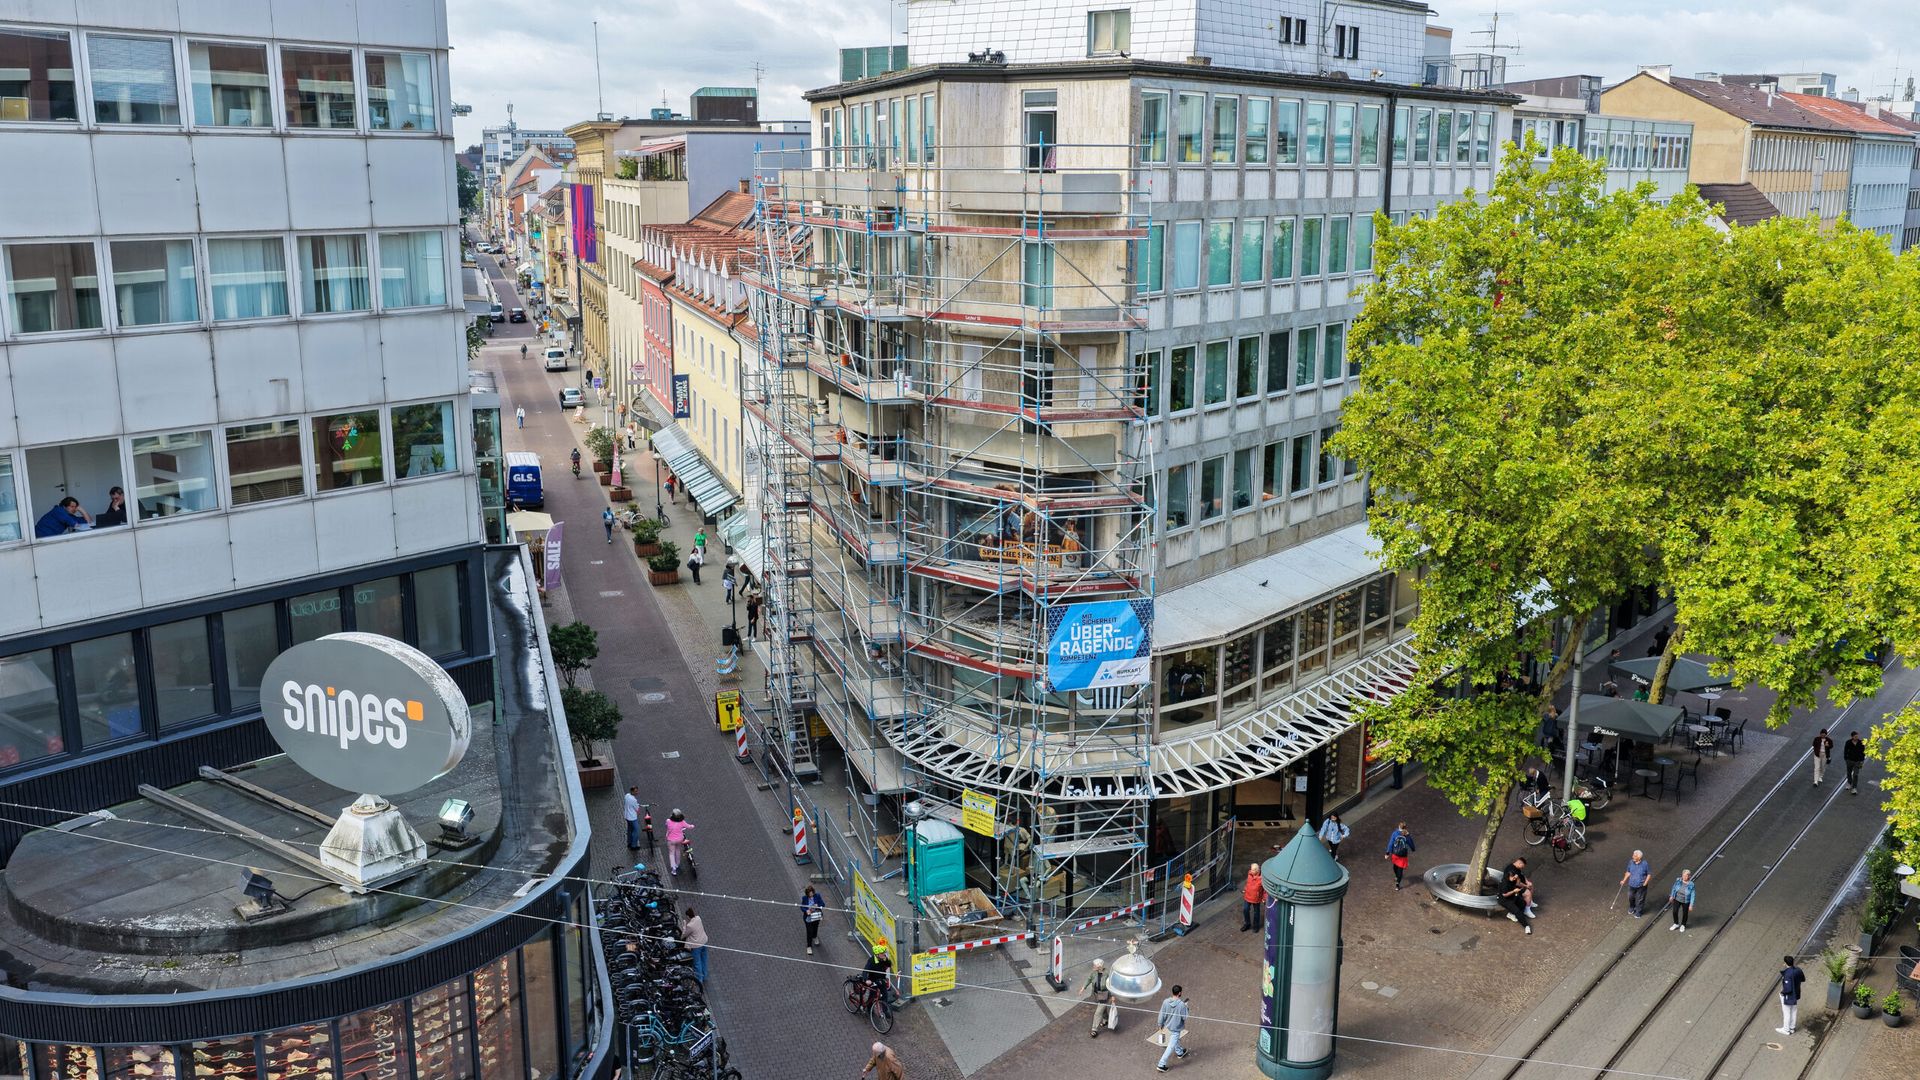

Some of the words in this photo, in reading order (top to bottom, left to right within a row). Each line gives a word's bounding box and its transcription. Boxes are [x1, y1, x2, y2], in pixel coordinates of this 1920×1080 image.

[675, 380, 684, 414] TOMMY
[547, 541, 561, 570] SALE
[1082, 617, 1117, 625] SICHERHEIT
[1070, 623, 1121, 640] ÜBER-
[1060, 636, 1134, 656] RAGENDE
[1060, 653, 1097, 661] KOMPETENZ
[282, 680, 408, 750] snipes
[1066, 785, 1102, 798] Foot
